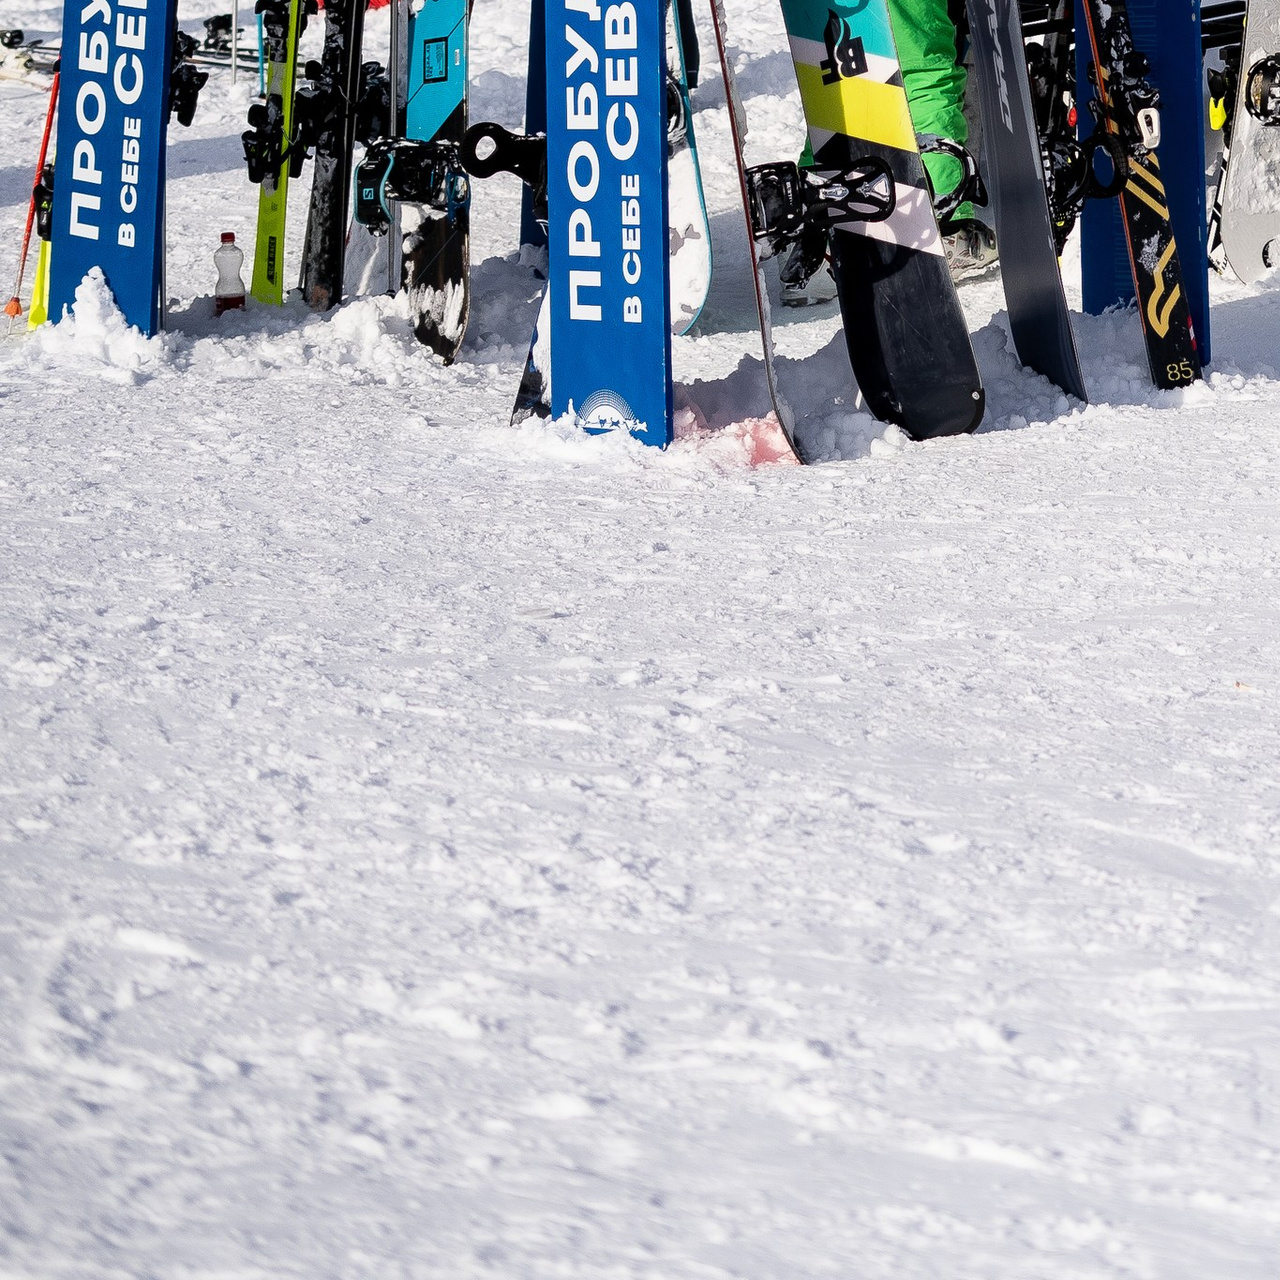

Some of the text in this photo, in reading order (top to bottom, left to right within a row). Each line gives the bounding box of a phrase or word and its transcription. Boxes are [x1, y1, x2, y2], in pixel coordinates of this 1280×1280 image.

[120, 117, 142, 214] СЕБЕ
[118, 223, 136, 248] В
[621, 175, 642, 285] СЕБЕ
[623, 296, 642, 323] В
[1166, 361, 1194, 381] 85
